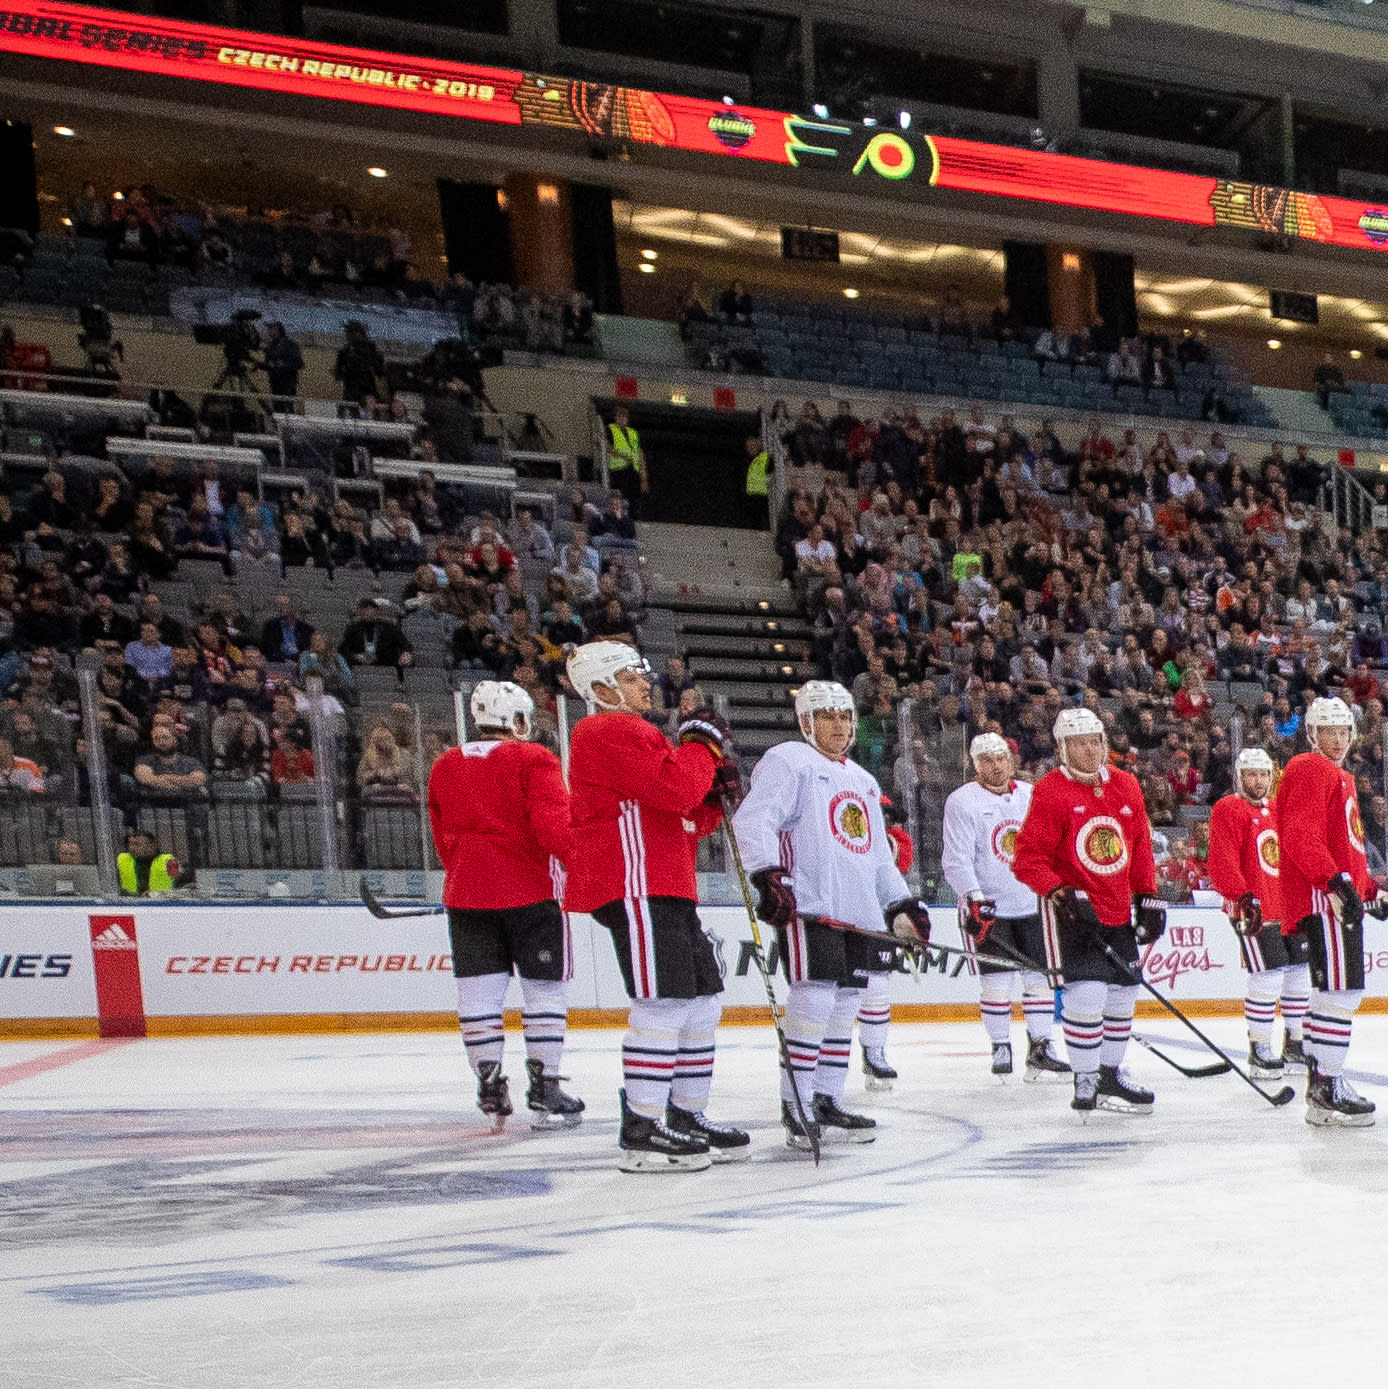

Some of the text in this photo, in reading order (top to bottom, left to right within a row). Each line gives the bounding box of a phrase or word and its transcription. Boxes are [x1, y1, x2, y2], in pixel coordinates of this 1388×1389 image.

[217, 47, 299, 73] CZECH
[302, 59, 423, 92] REPUBLIC
[432, 78, 496, 101] 2019
[1170, 926, 1204, 948] LAS
[164, 954, 453, 975] CZECH REPUBLIC
